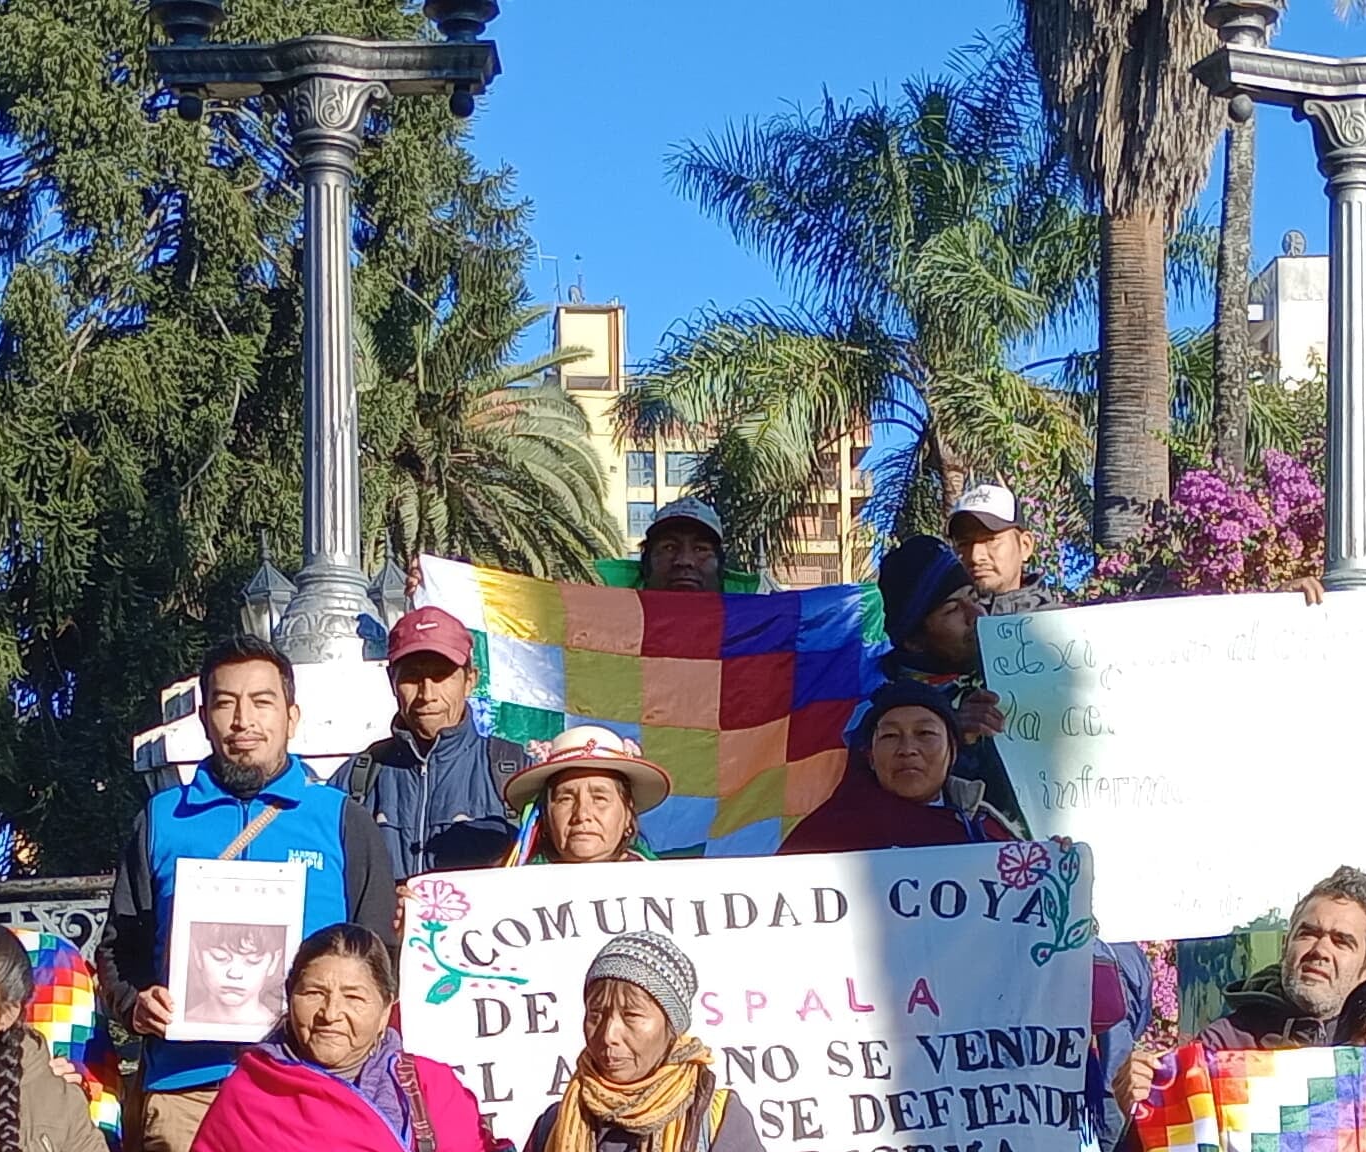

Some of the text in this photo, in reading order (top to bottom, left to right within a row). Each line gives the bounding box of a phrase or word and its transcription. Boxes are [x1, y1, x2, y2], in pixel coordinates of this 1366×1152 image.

[1003, 690, 1041, 741] la
[461, 878, 1048, 967] COMUNIDAD COYA
[473, 977, 940, 1038] DE SPALA
[721, 1044, 800, 1086] NO
[827, 1040, 892, 1080] SE
[916, 1025, 1086, 1075] VENDE
[759, 1096, 824, 1142] SE
